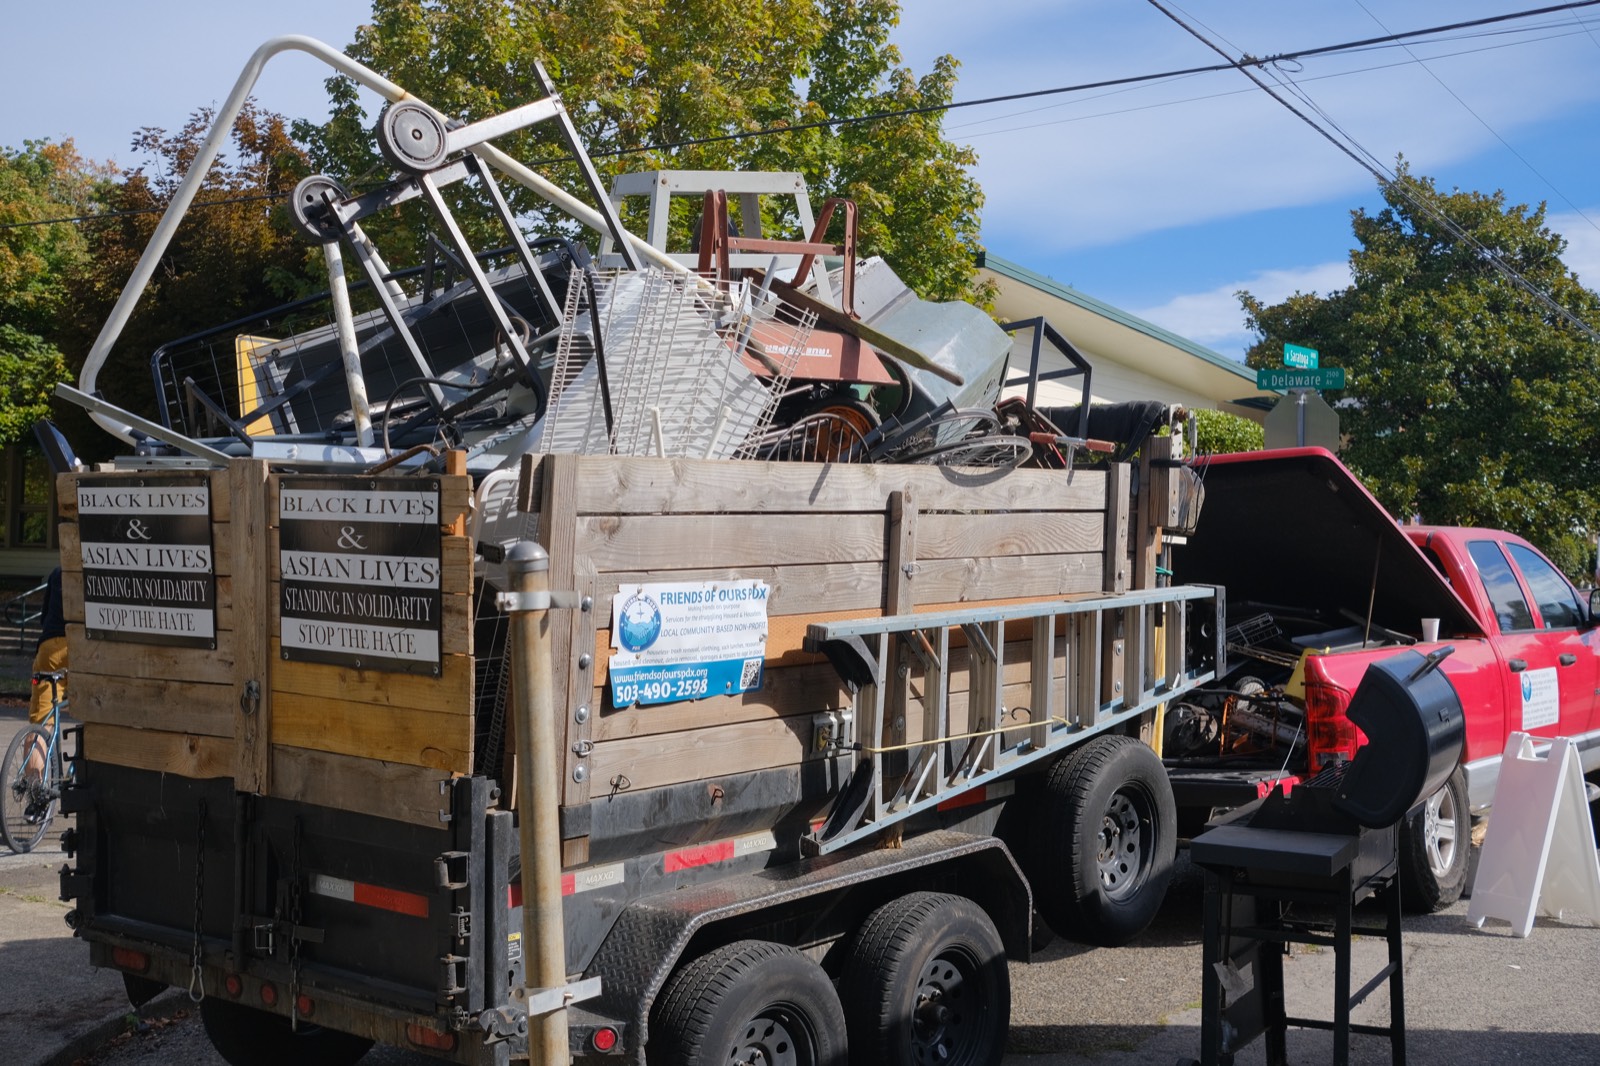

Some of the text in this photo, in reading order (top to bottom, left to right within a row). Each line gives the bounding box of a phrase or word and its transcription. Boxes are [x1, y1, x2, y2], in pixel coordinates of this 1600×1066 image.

[1272, 374, 1321, 386] Delaware
[80, 494, 205, 508] BLACK LIVES
[283, 497, 434, 516] BLACK LIVES
[126, 519, 151, 540] &
[337, 526, 368, 550] &
[84, 547, 207, 568] ASIAN LIVES
[285, 556, 434, 584] ASIAN LIVES
[86, 575, 207, 602] STANDING IN SOLIDARITY
[660, 587, 766, 605] FRIENDS OF OURS PDX
[285, 587, 432, 622] STANDING IN SOLIDARITY
[98, 608, 195, 631] STOP THE HATE
[661, 622, 766, 637] LOCAL COMMUNITY BASED NON-PROFIT
[299, 624, 416, 654] STOP THE HATE
[614, 668, 708, 684] www.friendsofourspdx.org
[617, 679, 708, 703] 503-490-2598
[742, 838, 767, 850] MAXXO
[320, 881, 344, 893] MAXXO
[585, 872, 614, 884] MAXXO
